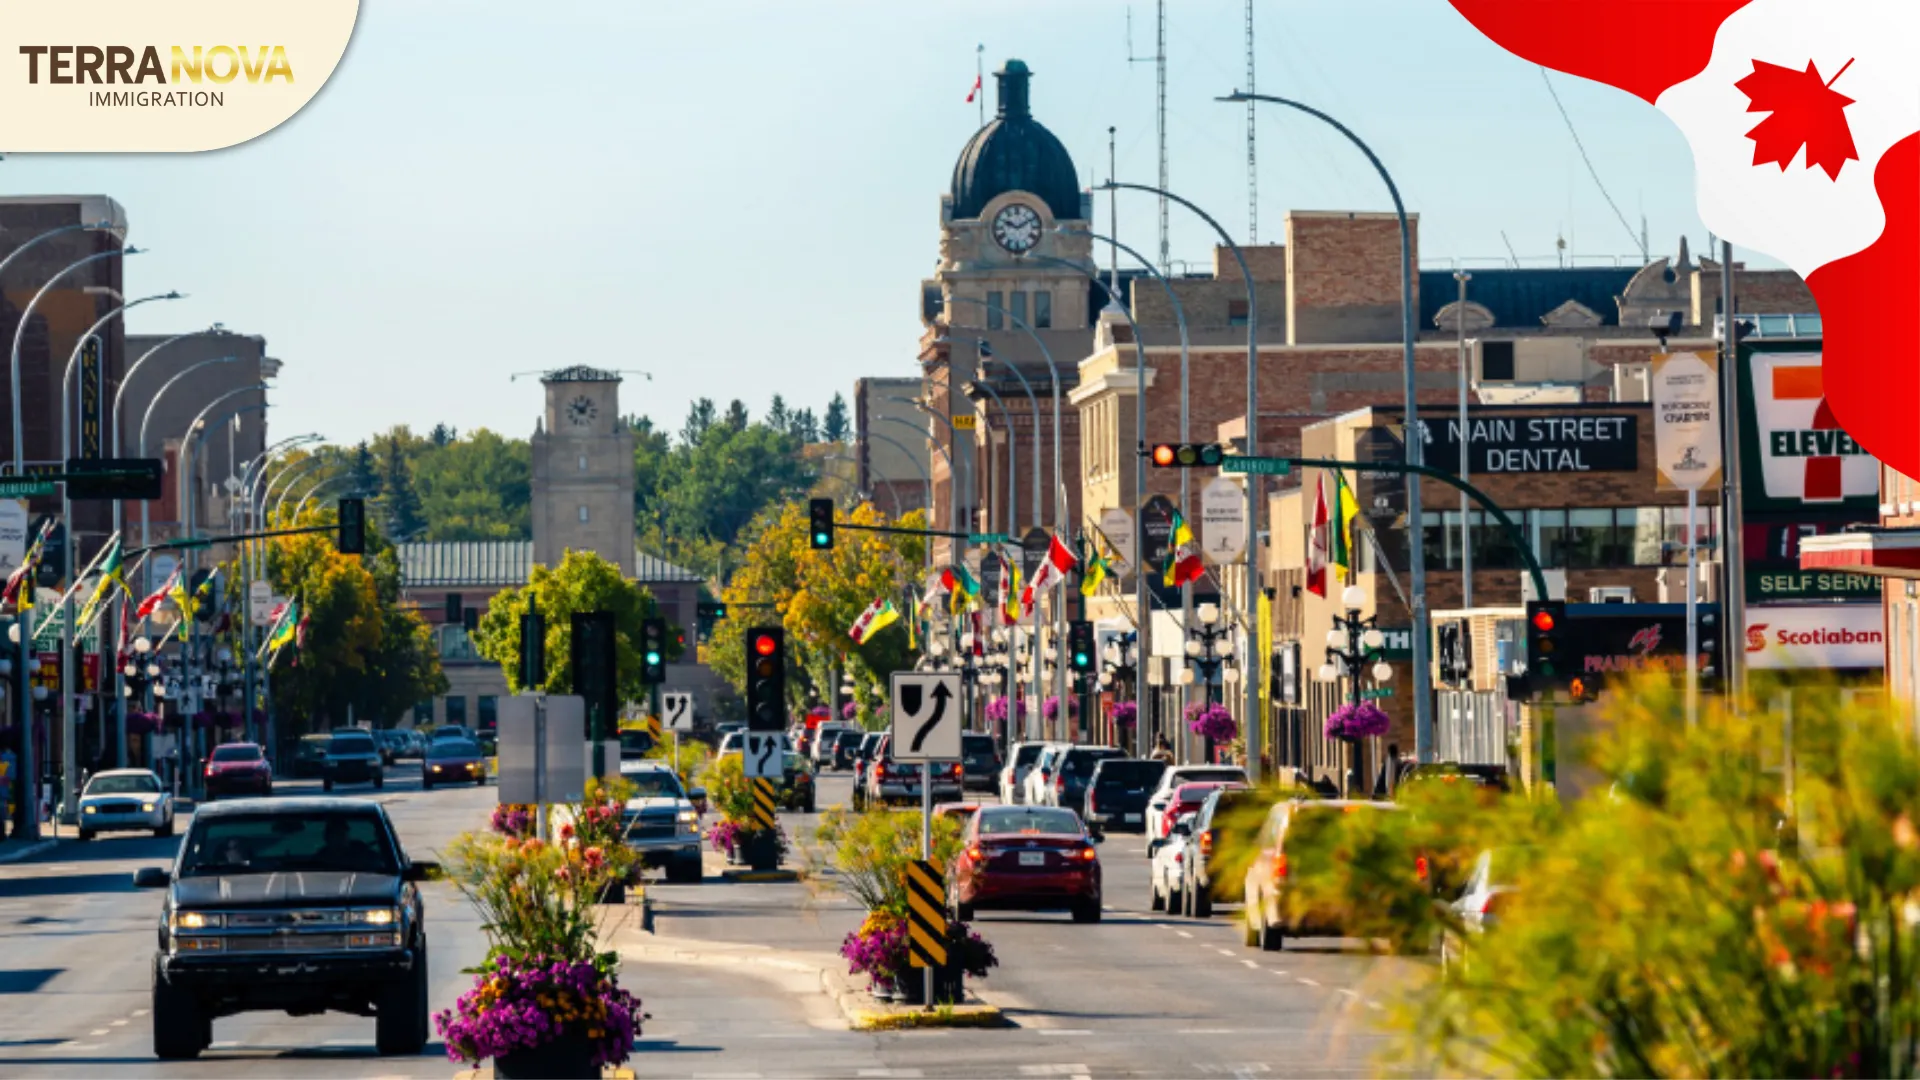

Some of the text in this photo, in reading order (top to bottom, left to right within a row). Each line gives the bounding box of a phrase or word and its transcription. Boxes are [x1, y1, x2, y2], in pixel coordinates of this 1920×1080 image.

[1448, 417, 1627, 443] MAIN STREET
[1224, 460, 1274, 473] CARIBOU
[1487, 449, 1590, 471] DENTAL
[1760, 575, 1813, 592] SELF
